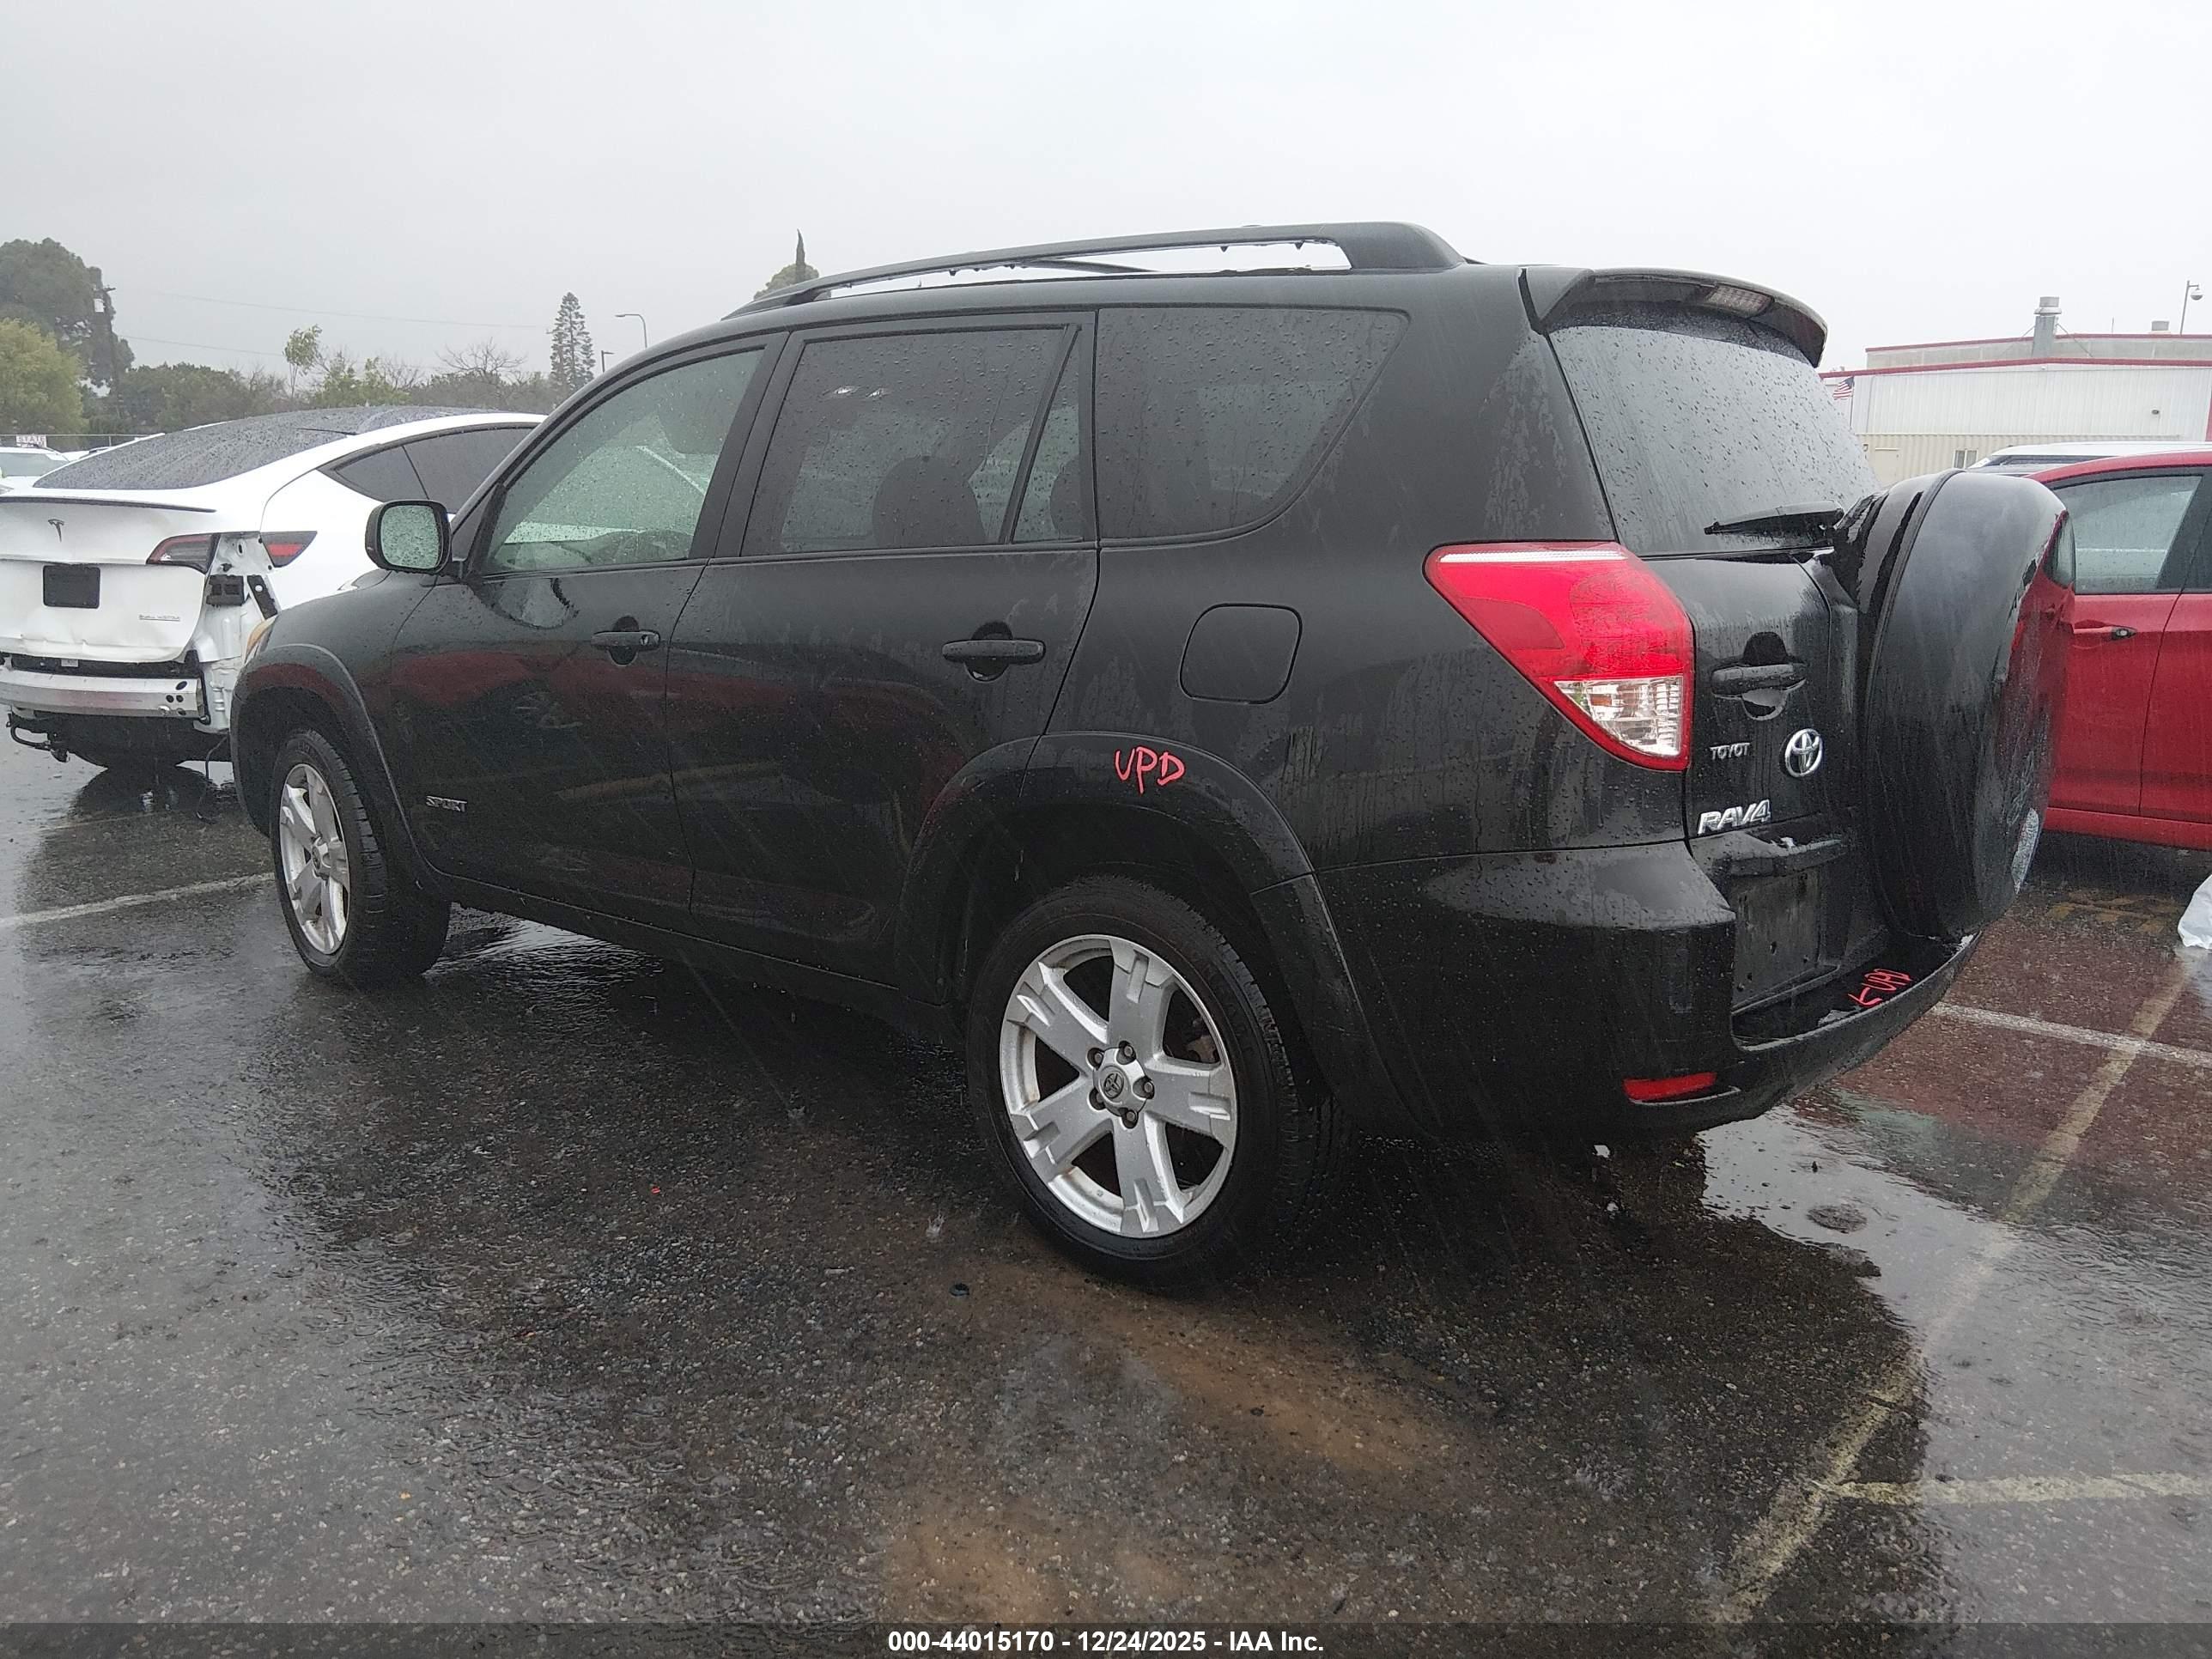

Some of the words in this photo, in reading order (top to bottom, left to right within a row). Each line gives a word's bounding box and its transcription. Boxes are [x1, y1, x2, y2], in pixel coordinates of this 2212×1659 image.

[1115, 745, 1185, 794] UPD
[425, 795, 468, 813] SPORT
[1697, 799, 1771, 835] RAV4
